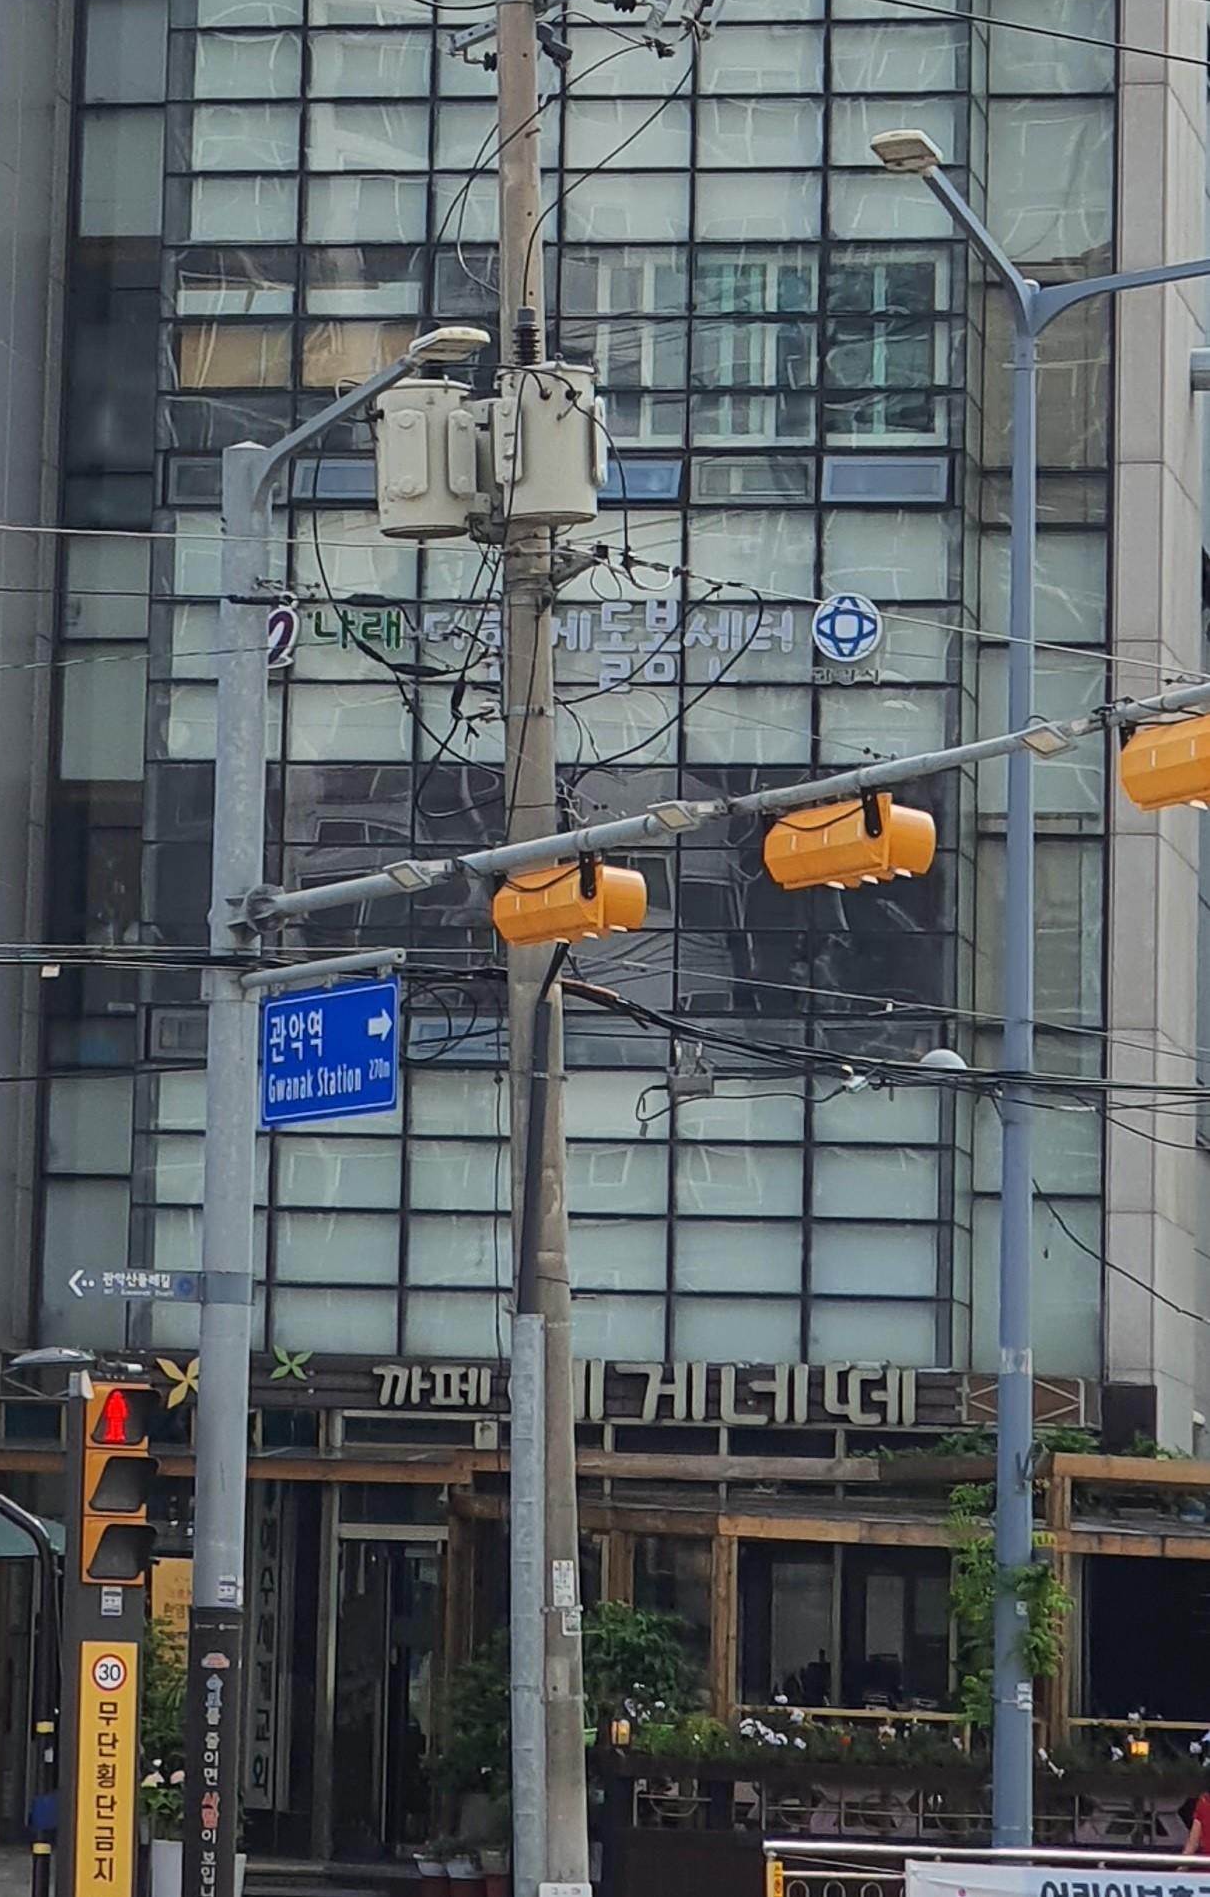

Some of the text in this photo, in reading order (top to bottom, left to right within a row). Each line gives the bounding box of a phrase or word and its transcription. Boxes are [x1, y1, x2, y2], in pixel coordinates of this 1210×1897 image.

[312, 607, 404, 651] 나래
[270, 1008, 323, 1063] 관악역
[269, 1058, 390, 1103] Gwanak Station 270m
[372, 1363, 491, 1407] 까페
[98, 1663, 122, 1683] 30
[93, 1701, 119, 1883] 무단횡단금지
